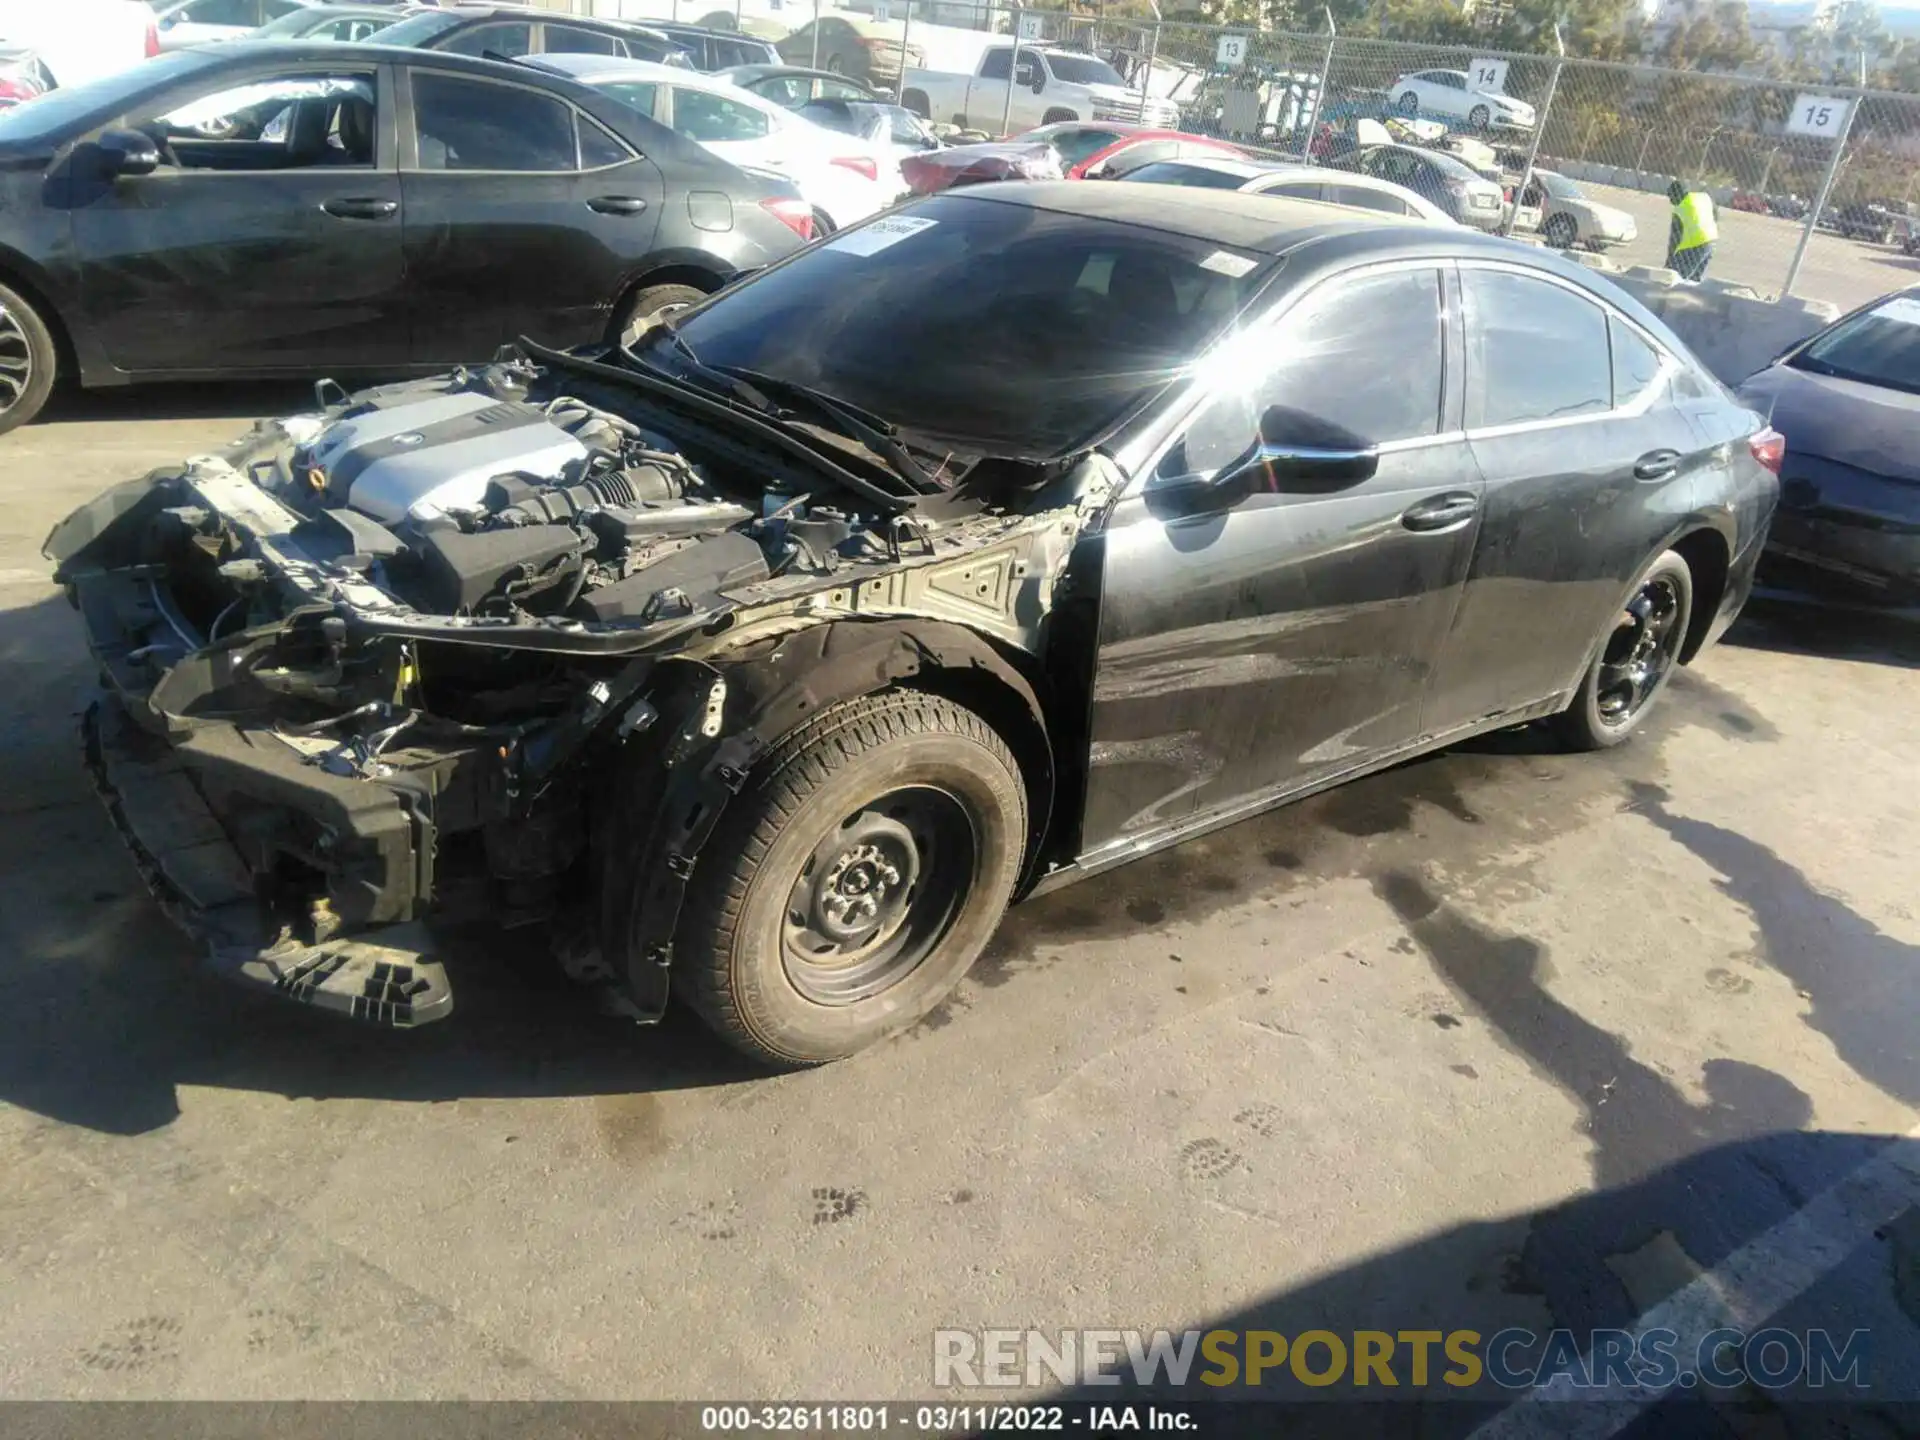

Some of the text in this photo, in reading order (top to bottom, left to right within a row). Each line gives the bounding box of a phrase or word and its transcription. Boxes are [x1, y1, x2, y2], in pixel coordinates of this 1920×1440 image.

[1226, 42, 1239, 57] 13
[1478, 67, 1496, 85] 14
[1806, 105, 1832, 127] 15
